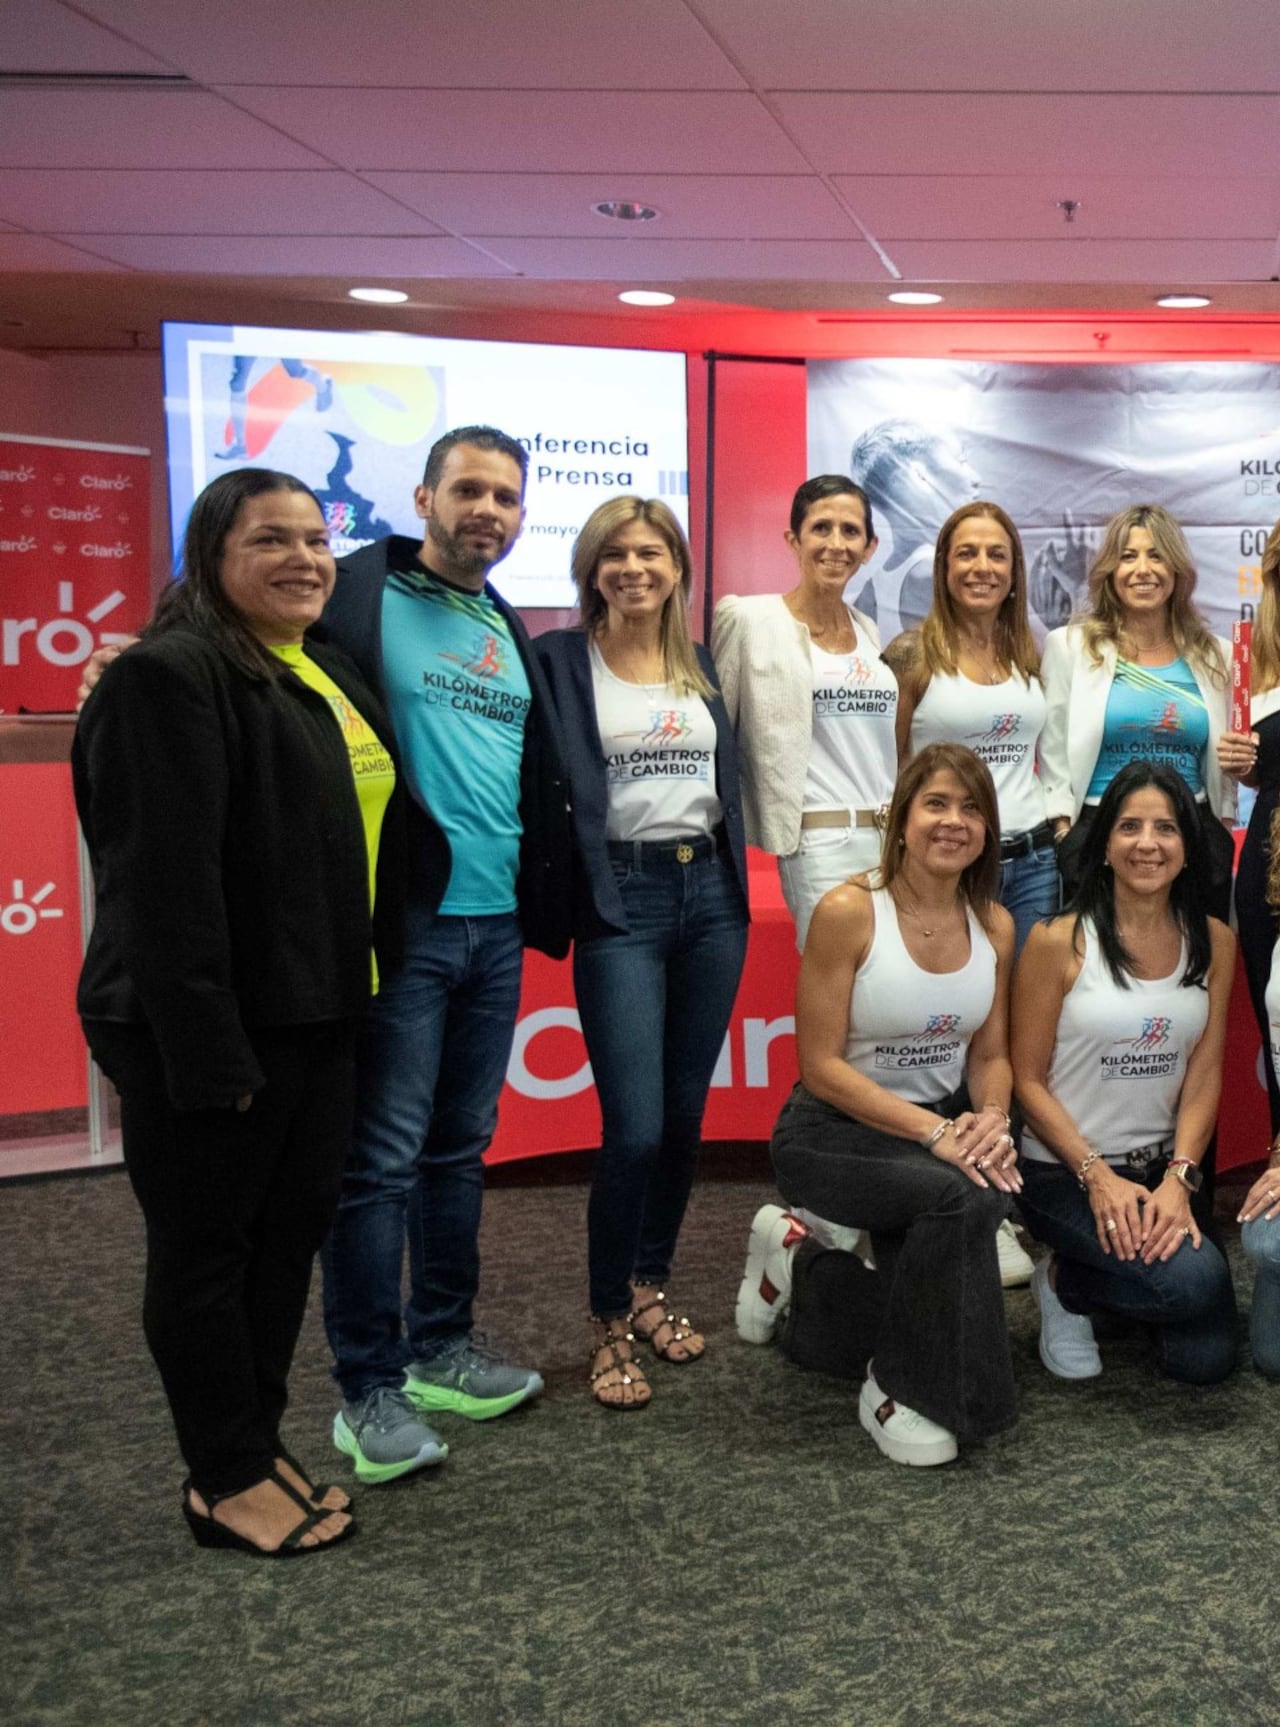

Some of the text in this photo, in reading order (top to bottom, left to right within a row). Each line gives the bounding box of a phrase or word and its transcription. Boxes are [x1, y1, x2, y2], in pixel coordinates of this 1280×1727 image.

[516, 432, 648, 457] nferencia
[538, 465, 632, 486] Prensa
[1243, 480, 1272, 496] DE
[530, 525, 578, 538] mayo
[423, 671, 531, 713] KILÓMETROS
[812, 686, 897, 702] KILÓMETROS
[425, 690, 515, 724] DE CAMBIO
[815, 701, 836, 714] DE
[837, 701, 888, 713] CAMBIO
[973, 743, 1030, 755] ÓMETROS
[605, 748, 711, 767] KILÓMETROS
[982, 754, 1021, 764] AMBIO
[607, 767, 630, 780] DE
[631, 763, 698, 777] CAMBIO
[875, 1040, 960, 1056] KILÓMETROS
[876, 1054, 897, 1067] DE
[898, 1053, 952, 1067] CAMBIO
[1101, 1051, 1179, 1066] KILÓMETROS
[1101, 1066, 1119, 1078] DE
[1120, 1063, 1170, 1076] CAMBIO
